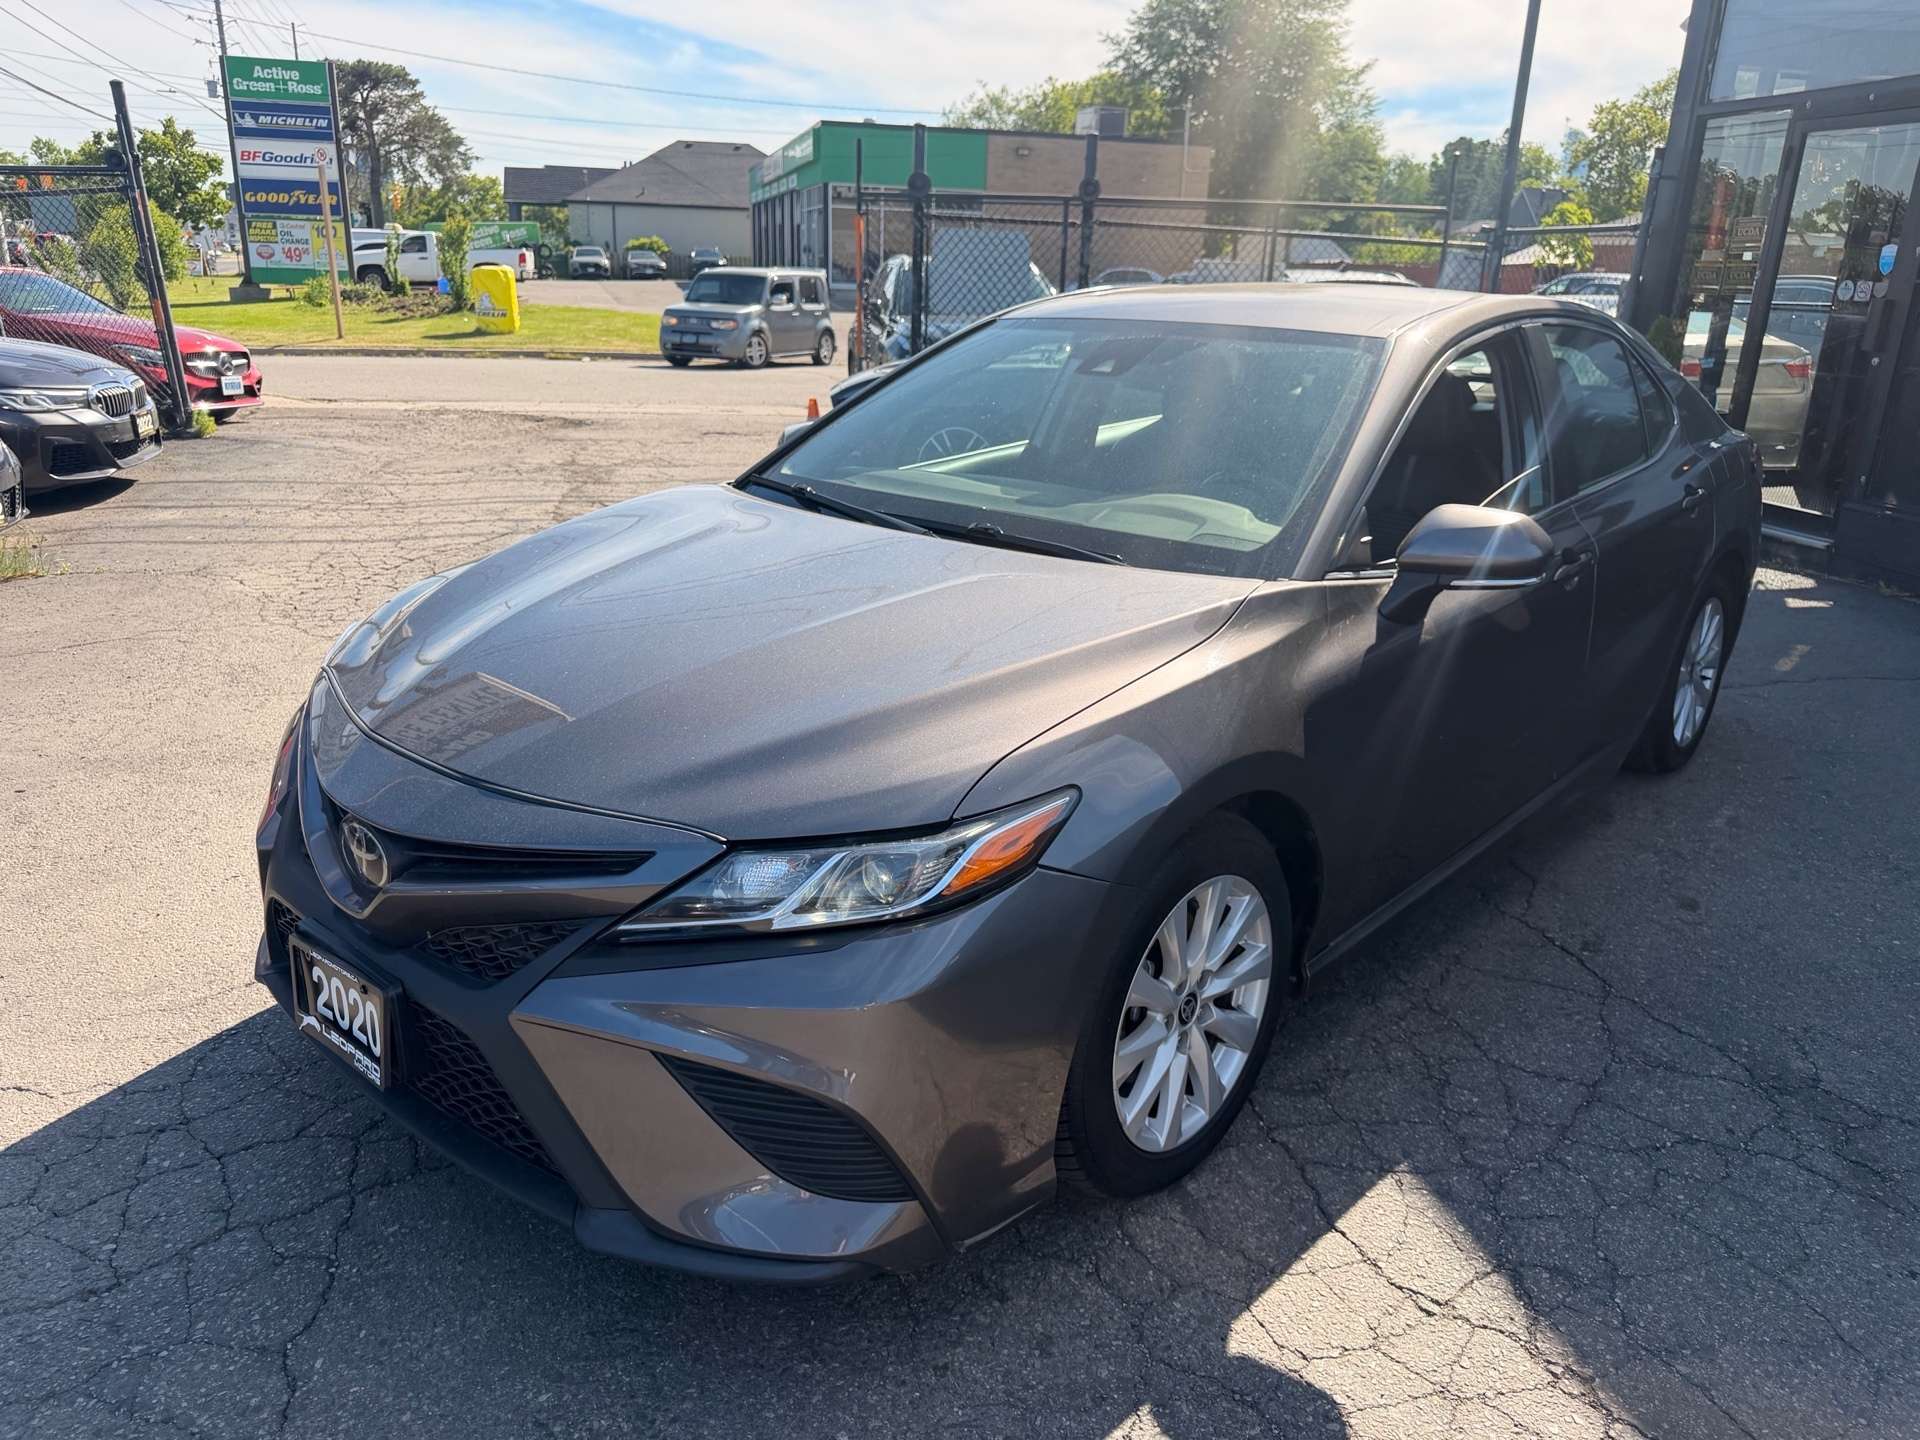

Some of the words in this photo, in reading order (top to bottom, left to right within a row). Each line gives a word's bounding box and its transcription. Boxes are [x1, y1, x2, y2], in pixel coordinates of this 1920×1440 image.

[253, 65, 300, 81] Active
[257, 115, 329, 128] MICHELIN
[240, 149, 333, 165] BFGoodri
[312, 965, 381, 1058] 2020
[322, 1024, 381, 1078] LEOPARD
[354, 1060, 381, 1086] MOTORS
